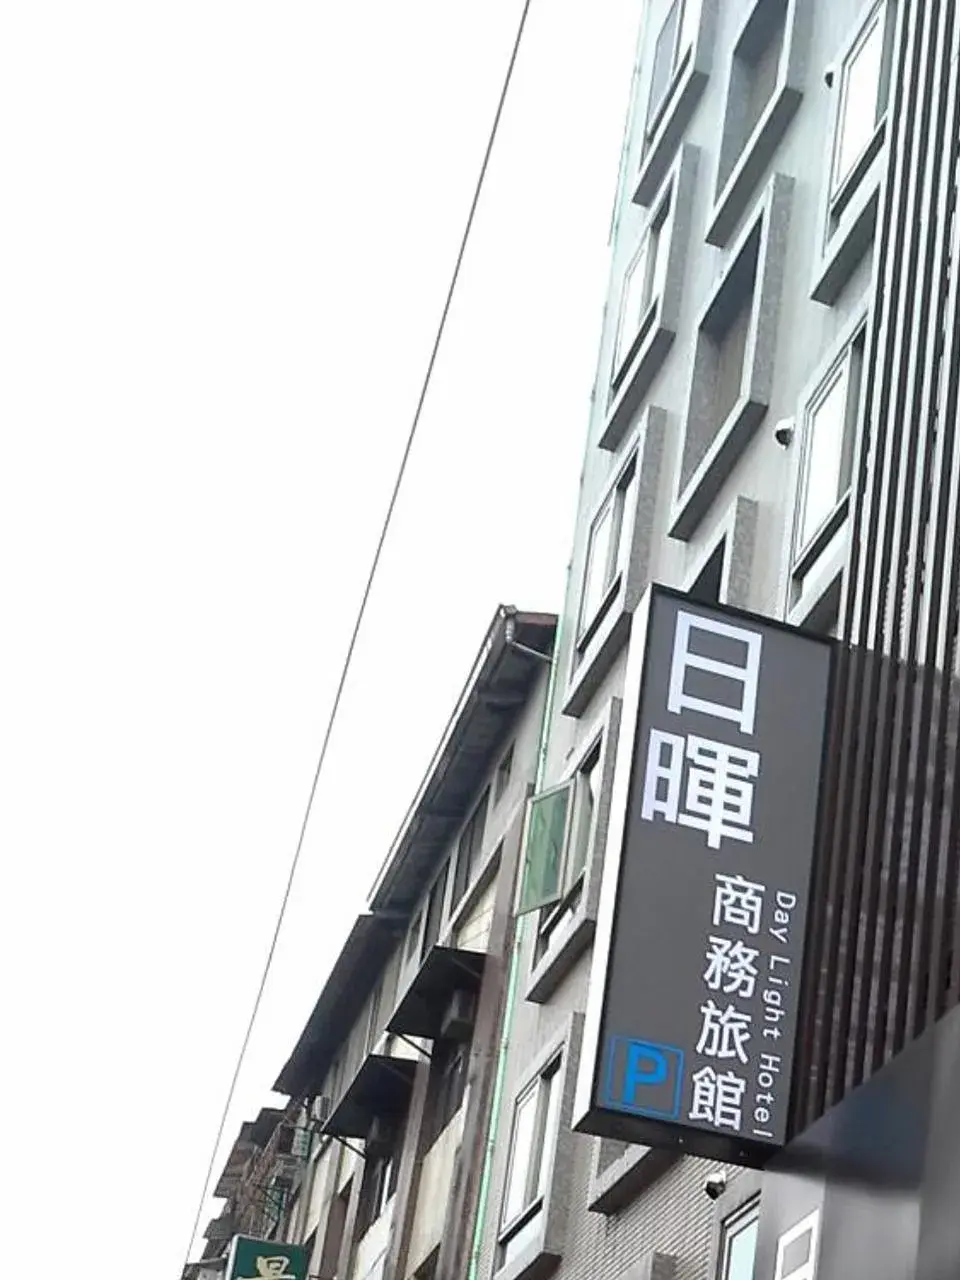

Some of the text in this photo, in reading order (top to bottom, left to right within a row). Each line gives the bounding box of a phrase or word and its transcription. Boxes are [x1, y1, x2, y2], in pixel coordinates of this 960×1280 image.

[640, 609, 763, 849] 日暉
[621, 1042, 668, 1107] P
[687, 872, 766, 1132] 商務旅館
[752, 891, 797, 1138] Day Light Hotel
